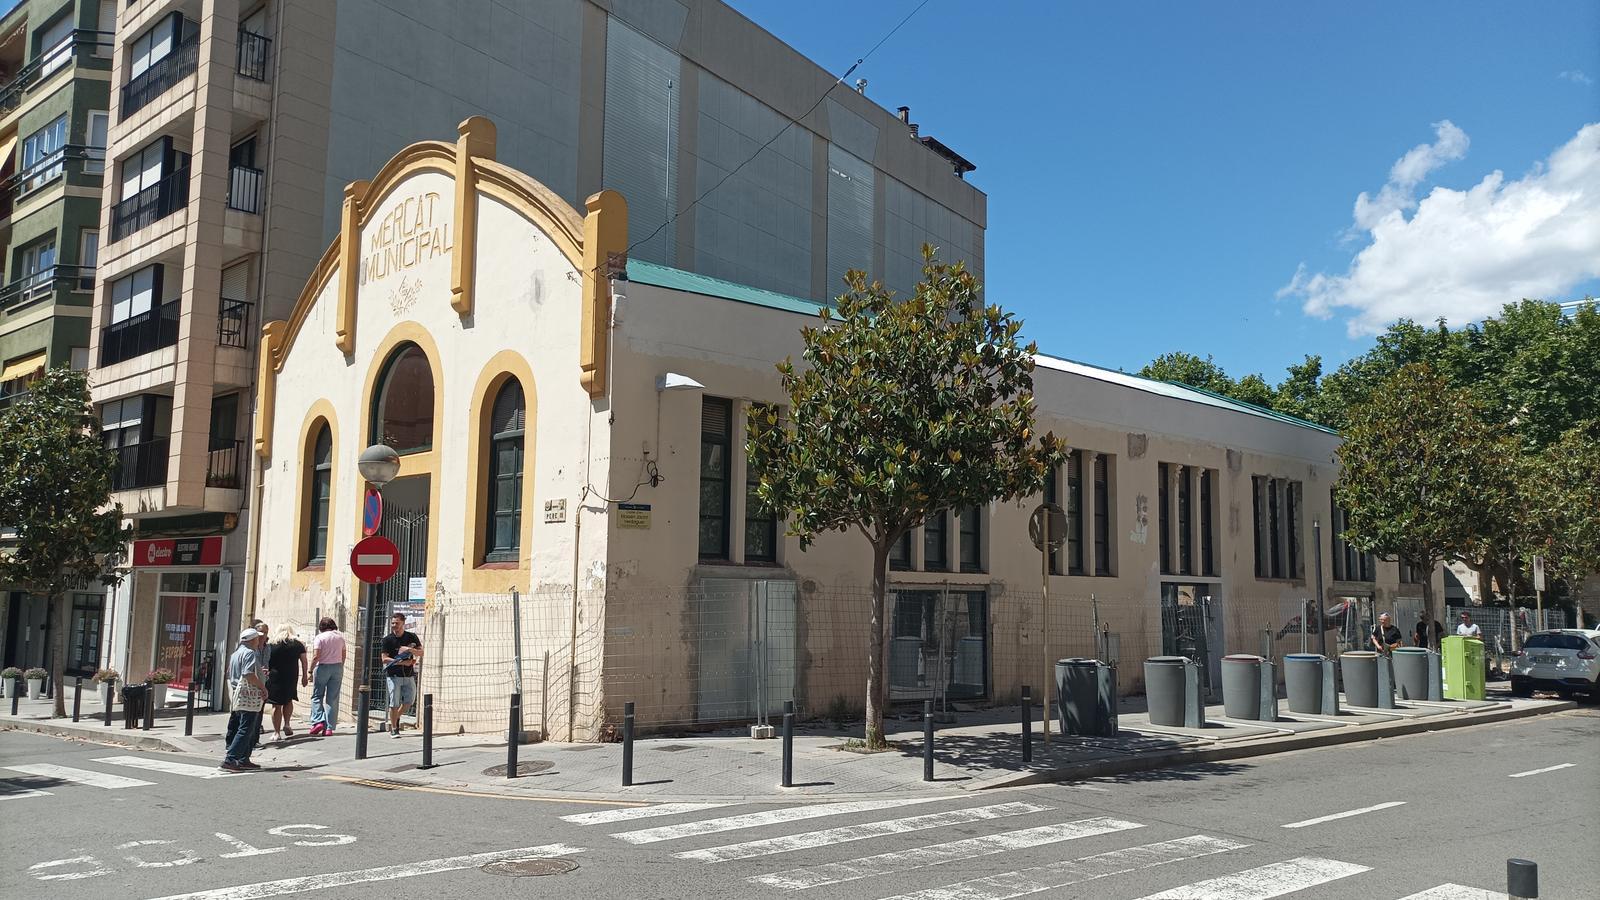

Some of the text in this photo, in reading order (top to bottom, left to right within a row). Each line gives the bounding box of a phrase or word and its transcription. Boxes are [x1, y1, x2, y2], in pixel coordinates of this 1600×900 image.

[371, 192, 440, 253] MERCAT
[364, 224, 453, 282] MUNICIPAL
[27, 823, 357, 881] STOP
